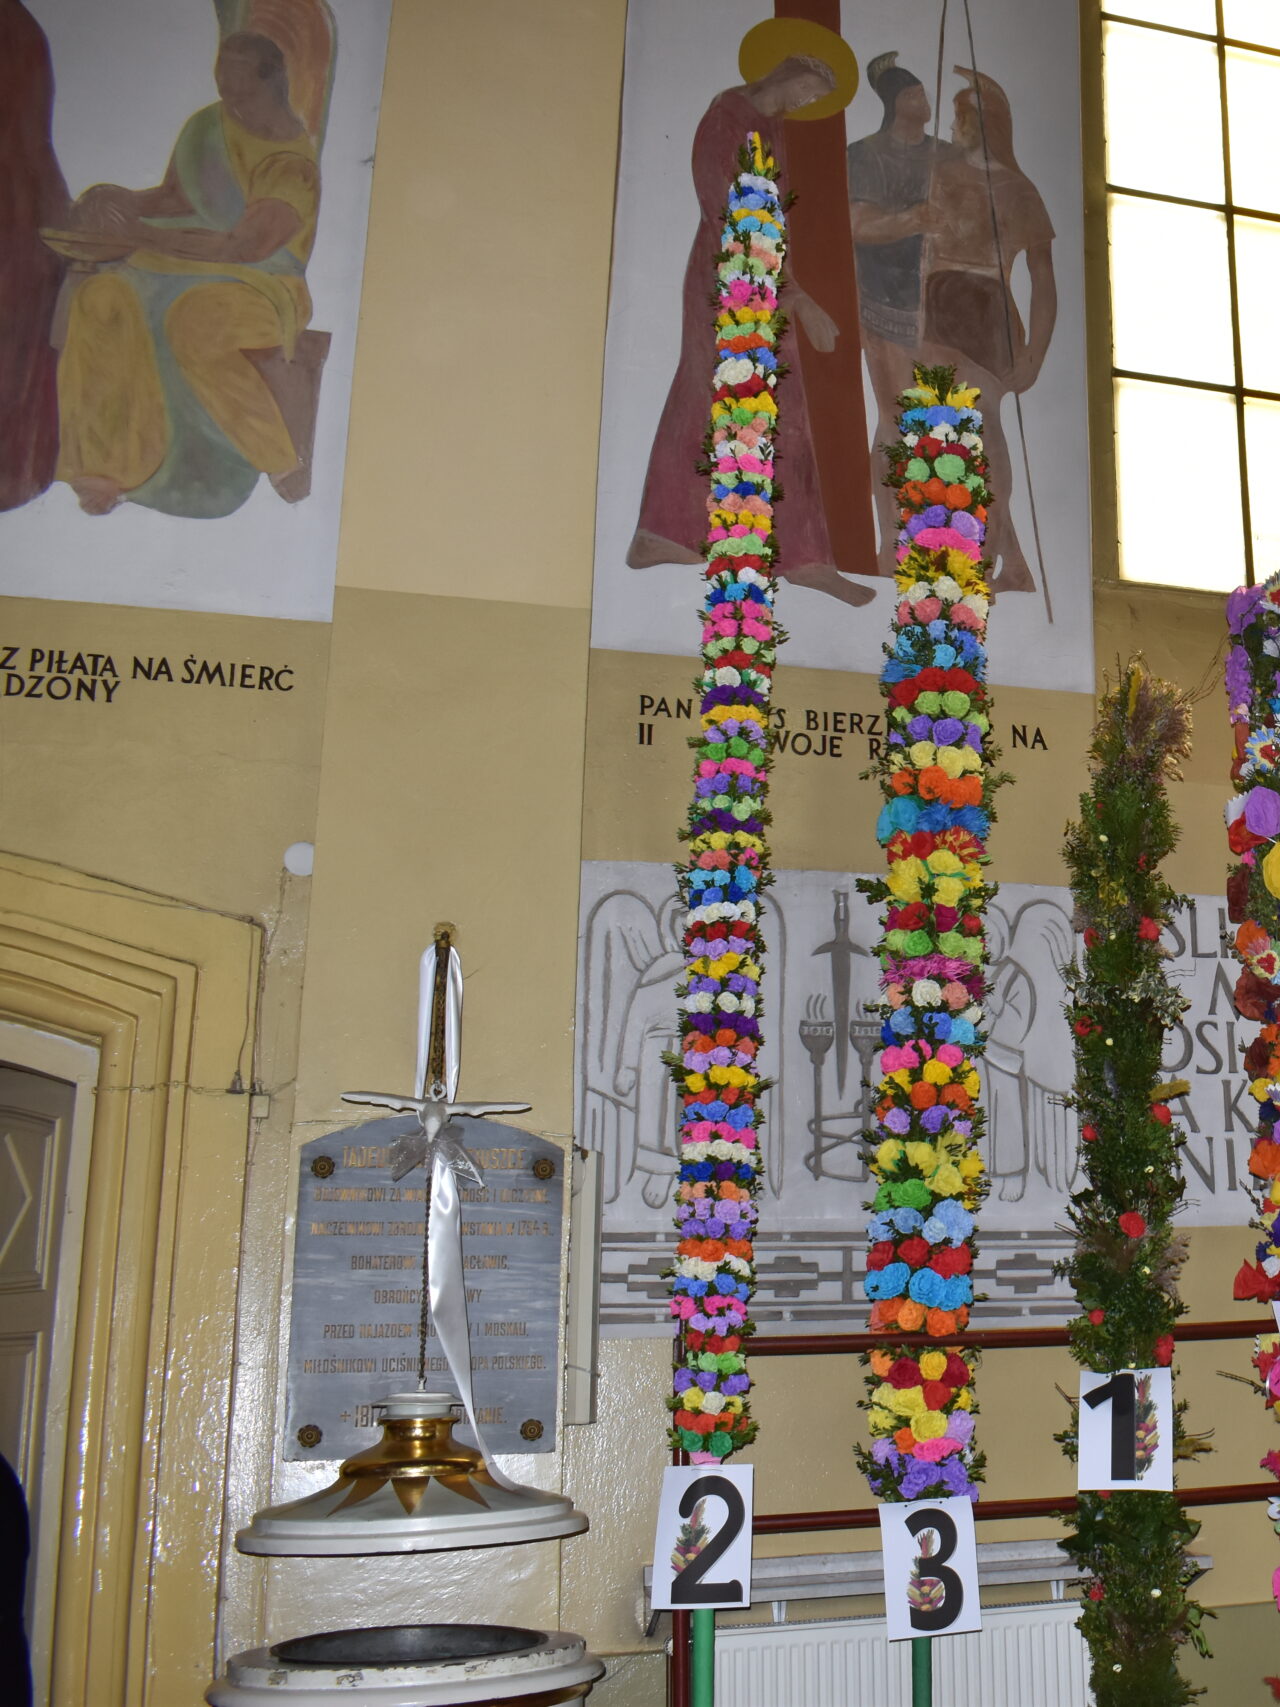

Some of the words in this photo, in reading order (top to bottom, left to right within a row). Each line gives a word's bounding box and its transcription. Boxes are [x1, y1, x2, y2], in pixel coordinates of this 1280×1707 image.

[4, 673, 121, 703] DZONY
[29, 648, 119, 678] PIŁATA
[131, 655, 174, 682] NA
[181, 654, 294, 691] ŚMIERĆ
[639, 695, 693, 720] PAN
[1011, 724, 1049, 750] NA
[771, 730, 843, 758] WOJE
[323, 1323, 355, 1339] PRZED
[1082, 1373, 1137, 1481] 1
[671, 1475, 746, 1605] 2
[904, 1508, 964, 1632] 3
